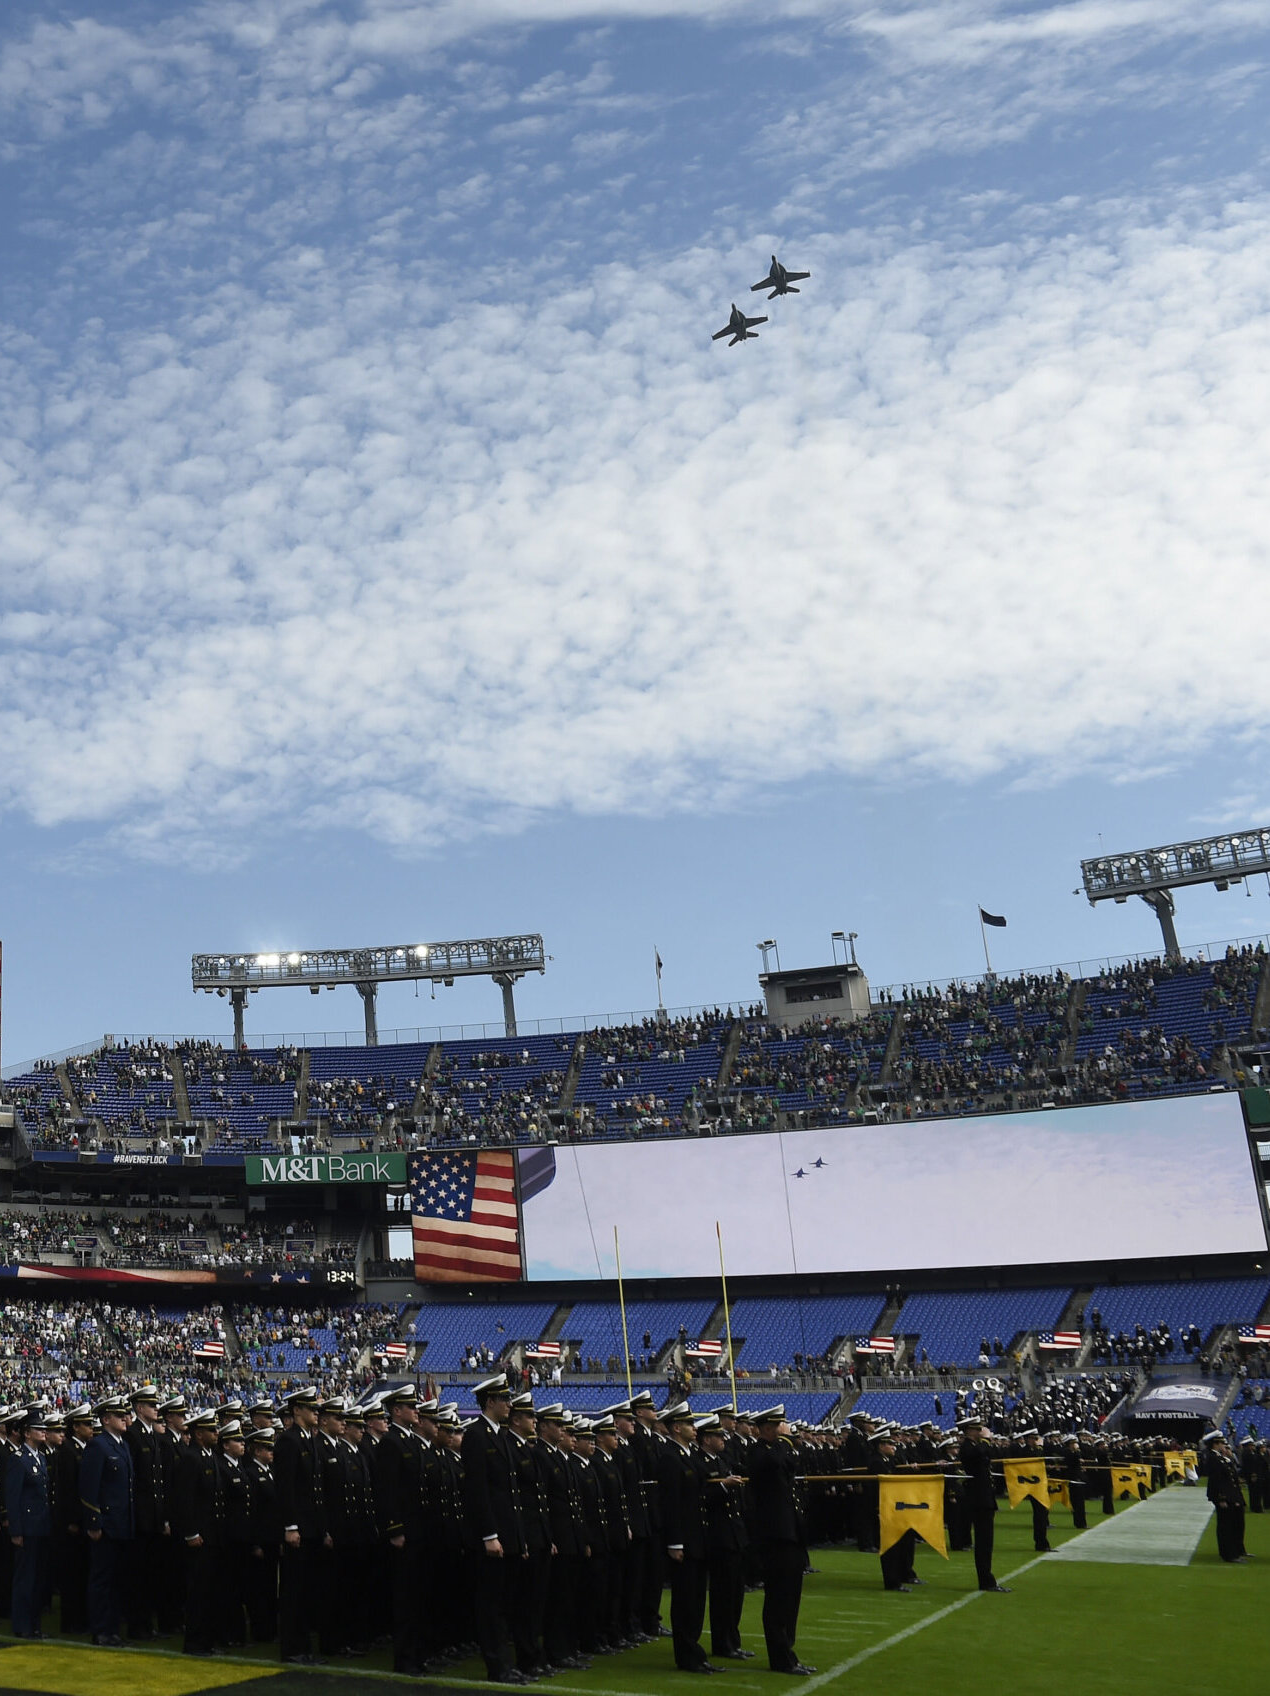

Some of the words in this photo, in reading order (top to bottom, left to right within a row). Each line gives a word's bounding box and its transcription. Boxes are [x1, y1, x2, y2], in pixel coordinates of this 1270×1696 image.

[113, 1155, 168, 1165] #RAVENSFLOCK
[260, 1156, 326, 1182] M&T
[329, 1155, 391, 1181] Bank
[326, 1270, 354, 1283] 13:24
[1017, 1475, 1041, 1484] 2
[895, 1502, 929, 1511] 1
